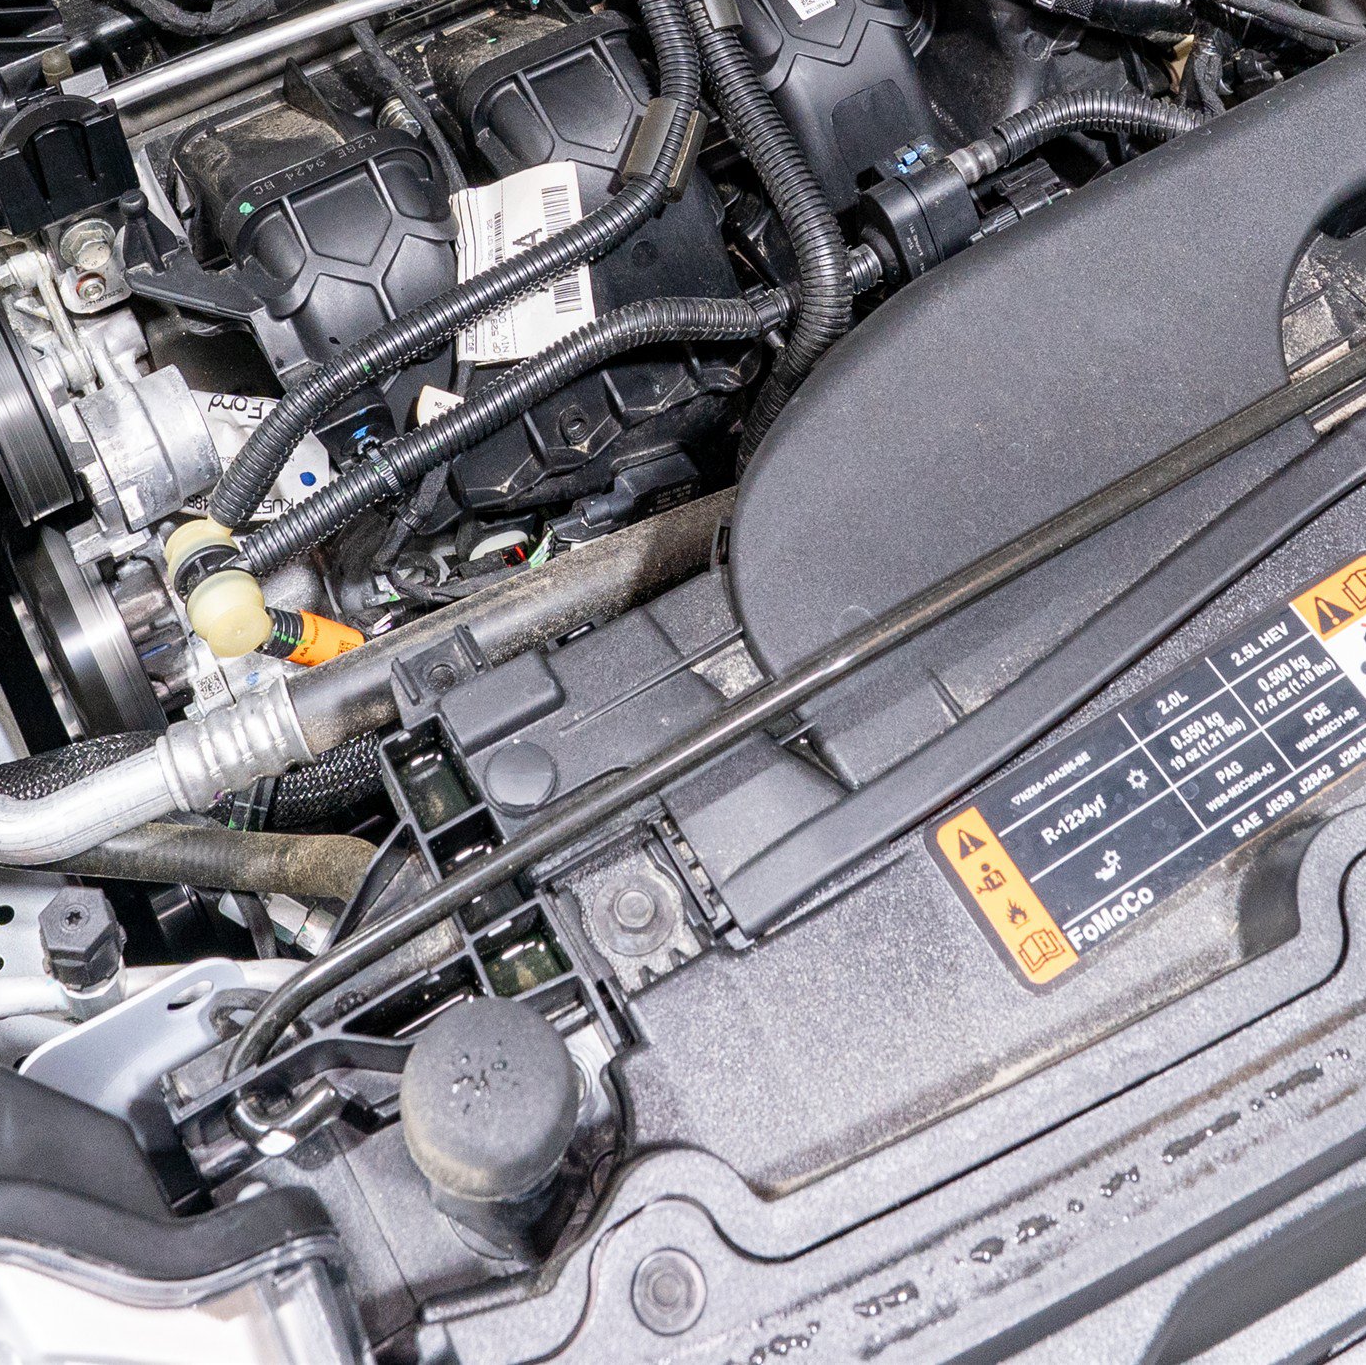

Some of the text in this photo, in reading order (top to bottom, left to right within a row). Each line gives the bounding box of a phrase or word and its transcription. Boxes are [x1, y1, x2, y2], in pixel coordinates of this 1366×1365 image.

[208, 394, 263, 420] Ford
[1230, 622, 1291, 668] 2.5L HEV
[1253, 656, 1337, 714] 17.6 oz (1.10 lbs)
[1257, 654, 1312, 693] 0.500 kg
[1156, 689, 1189, 716] 2.0L
[1303, 703, 1331, 727] POE
[1170, 710, 1226, 751] 0.550 kg
[1170, 717, 1248, 771] 19 oz (1.21 lbs)
[1216, 762, 1244, 786] PAG
[1041, 793, 1108, 846] R-1234yf
[1232, 812, 1263, 840] SAE
[1266, 791, 1296, 819] J639
[1298, 764, 1335, 797] J2842
[1066, 885, 1155, 951] FoMoCo
